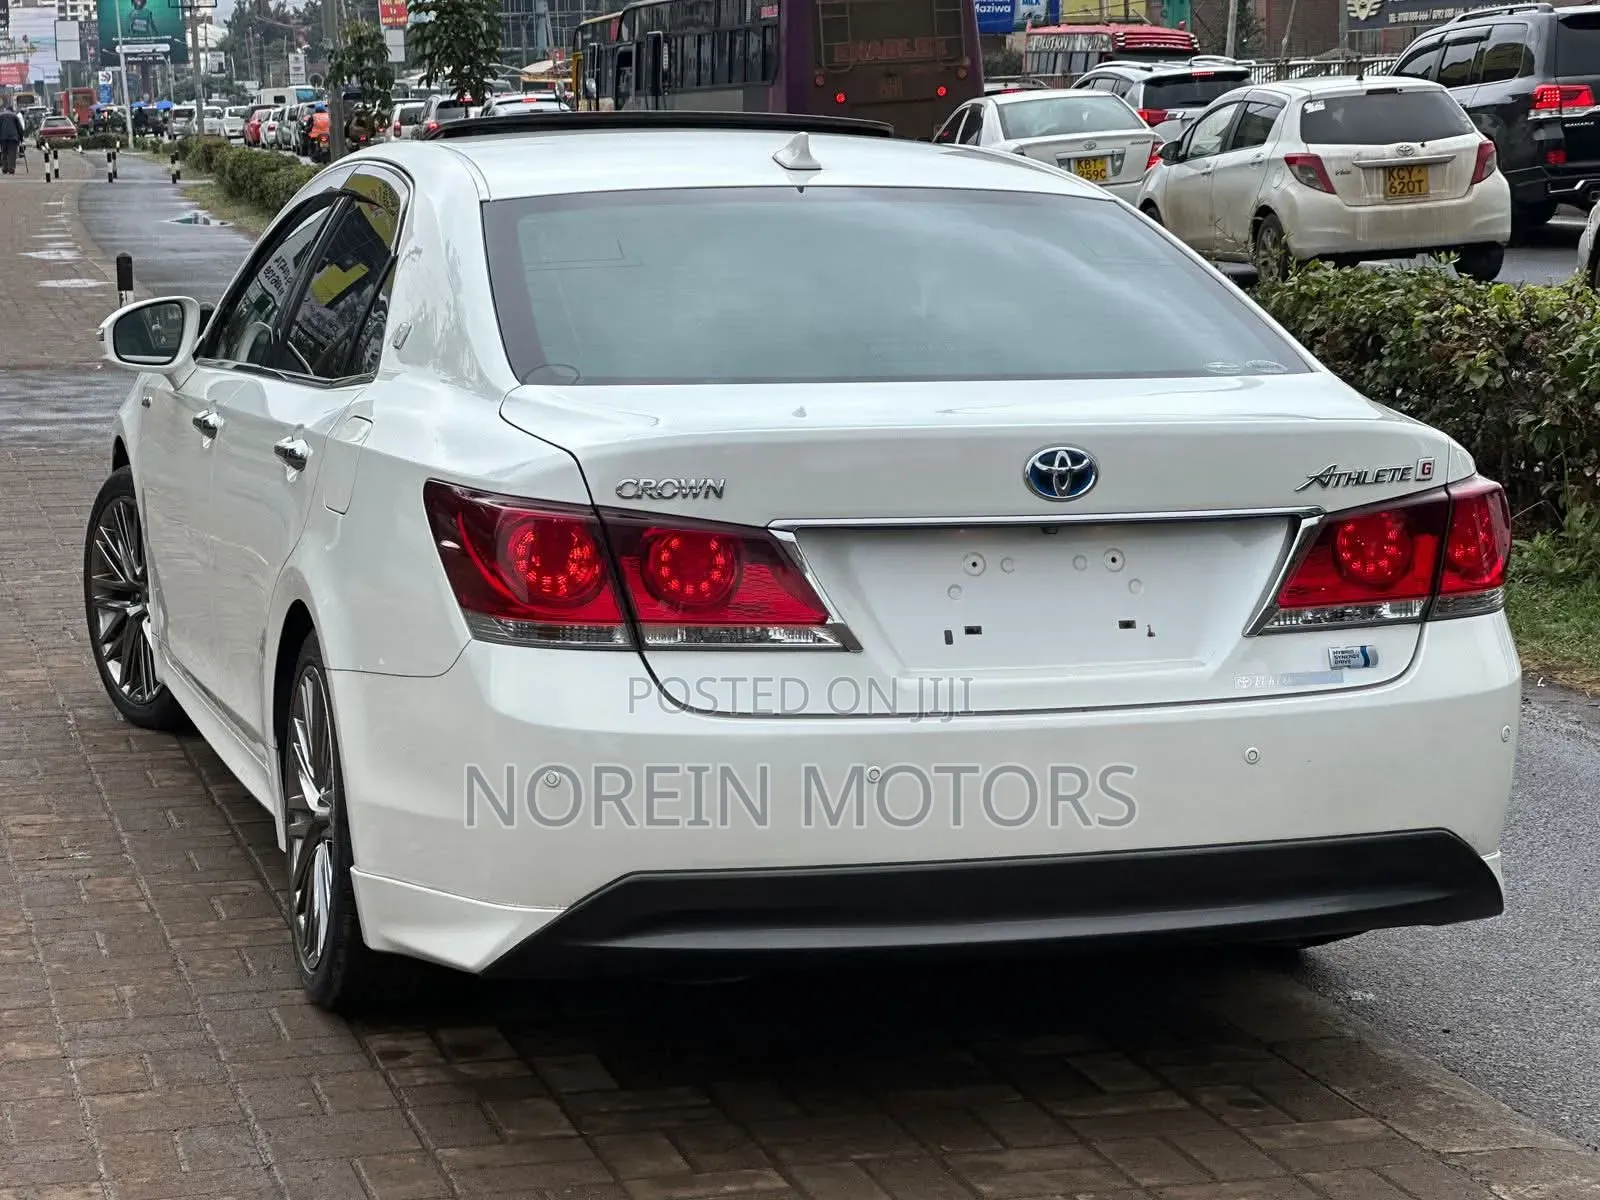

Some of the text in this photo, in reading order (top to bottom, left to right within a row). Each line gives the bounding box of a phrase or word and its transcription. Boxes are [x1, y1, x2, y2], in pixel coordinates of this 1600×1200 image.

[1077, 158, 1097, 170] KBT
[1387, 166, 1414, 181] KCY
[1389, 180, 1424, 195] 620T
[1295, 463, 1414, 492] ATHLETE
[615, 478, 726, 500] CROWN
